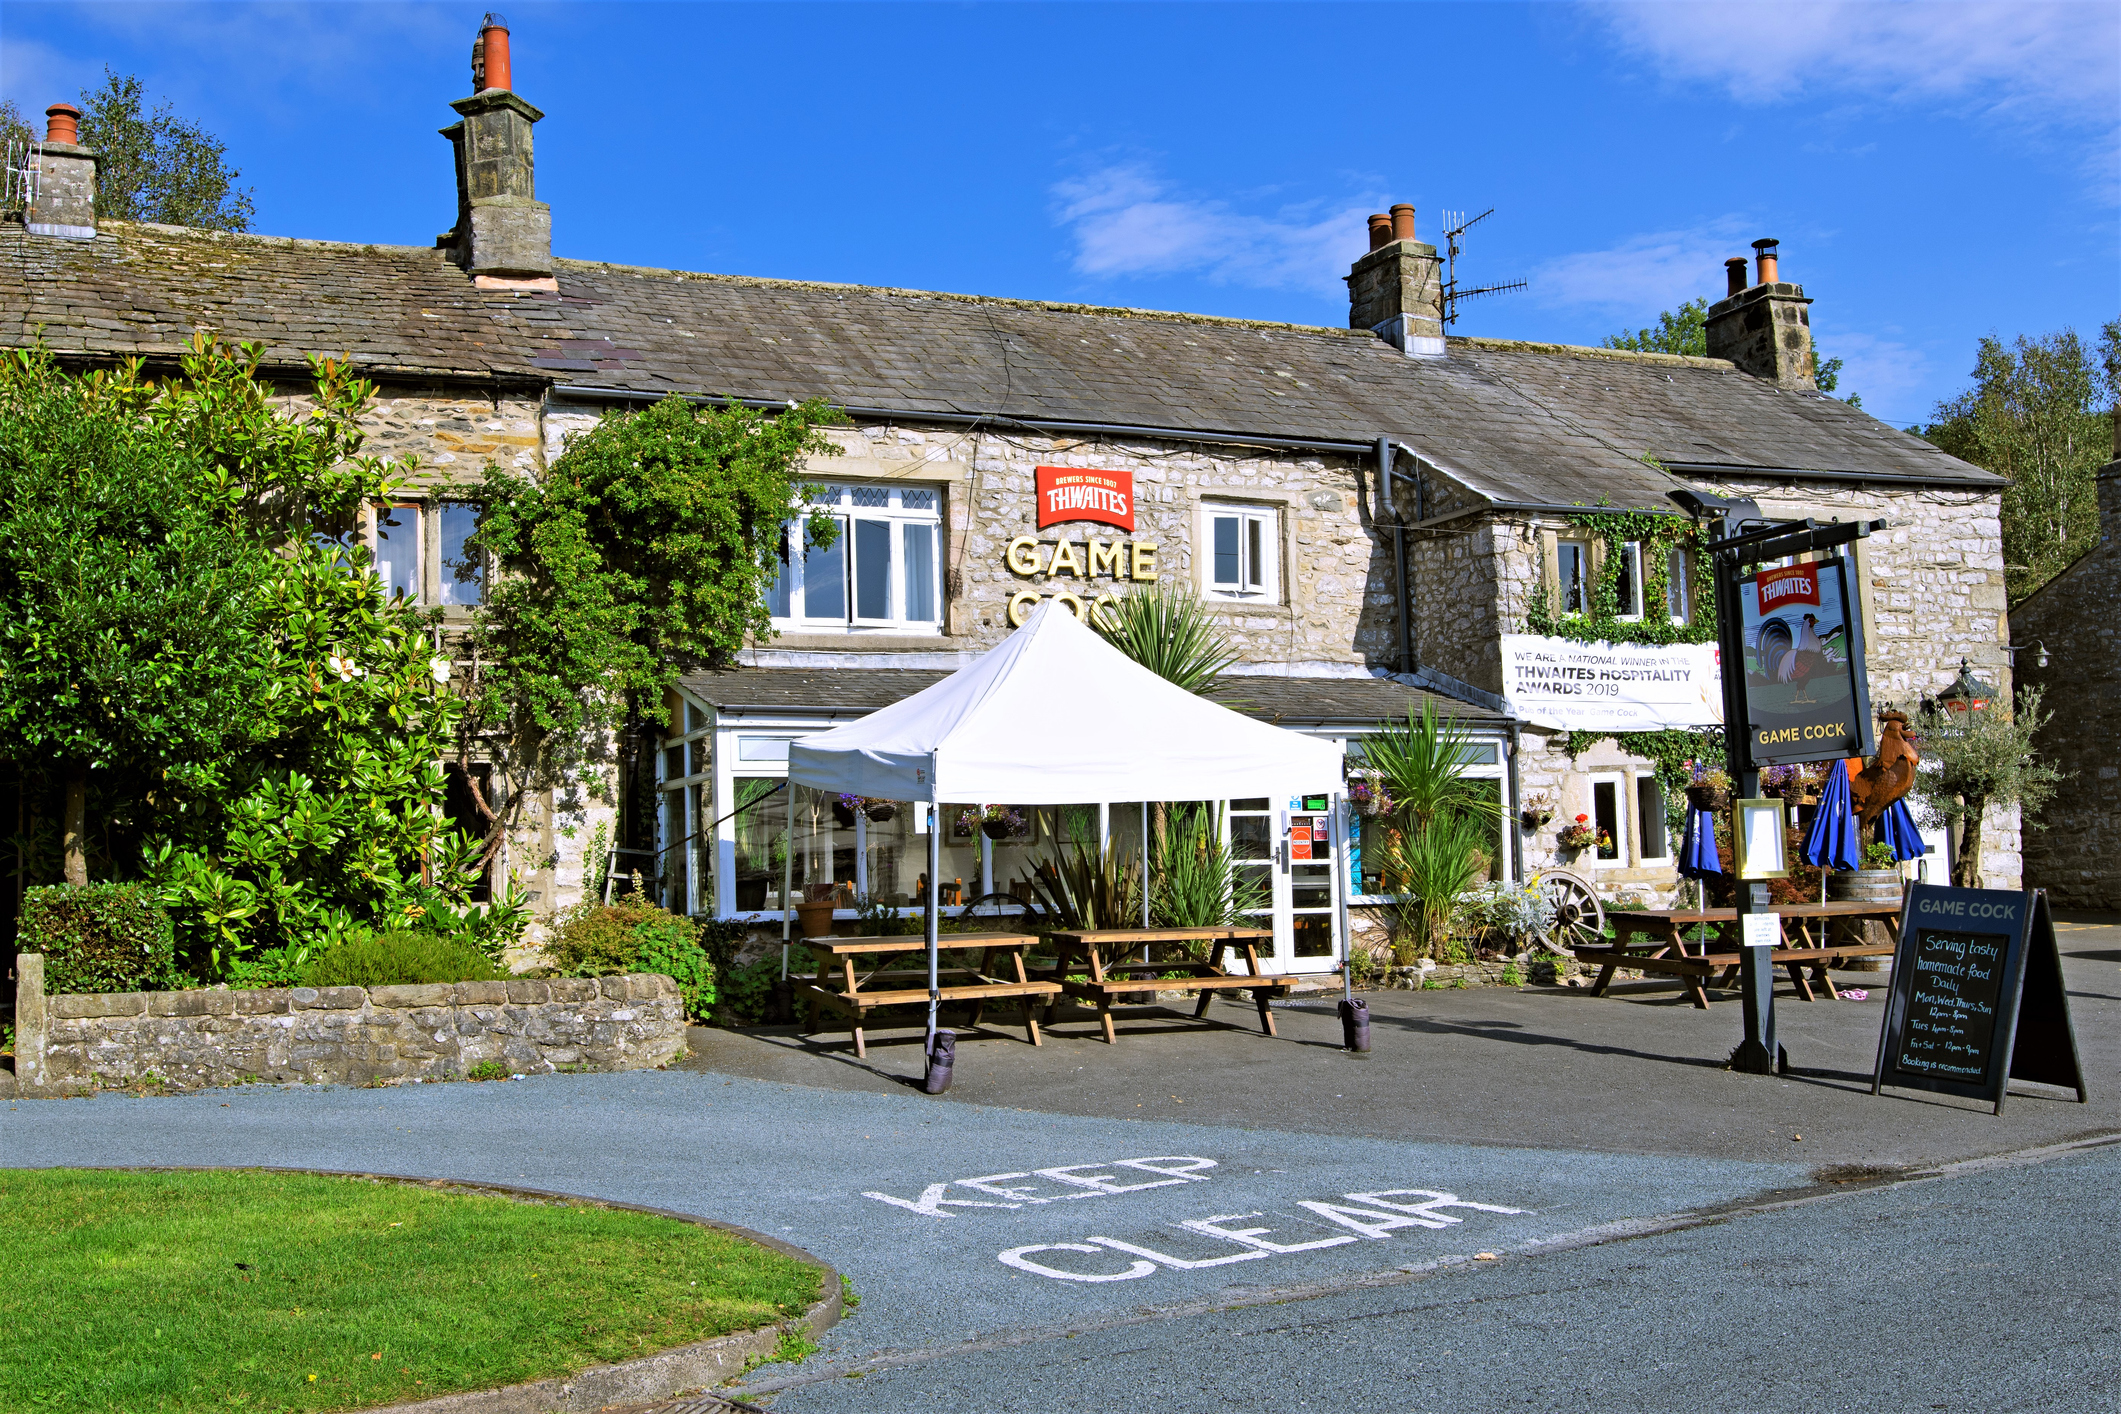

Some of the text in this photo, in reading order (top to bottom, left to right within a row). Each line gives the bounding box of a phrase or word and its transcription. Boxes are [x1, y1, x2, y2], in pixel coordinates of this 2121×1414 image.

[1055, 475, 1117, 488] BREWERS SINCE 1807
[1046, 485, 1128, 516] THWAITES
[1007, 535, 1159, 580] GAME
[1761, 577, 1812, 603] THWAITES
[1514, 651, 1691, 667] WE ARE A NATIONAL WINNER IN THE
[1515, 666, 1692, 682] THWAITES HOSPITALITY
[1515, 682, 1620, 697] AWARDS 2019
[1518, 706, 1535, 715] Pub
[1536, 707, 1547, 715] of
[1548, 707, 1564, 716] the
[1589, 708, 1615, 717] Game
[1617, 708, 1638, 717] Cock
[1758, 722, 1847, 745] GAME COCK
[1919, 899, 2016, 920] GAME COCK
[1925, 935, 1999, 962] Serving tasty
[1917, 955, 1991, 981] homemade food
[1929, 975, 1960, 996] Daily
[1911, 1019, 1929, 1031] Tues
[1901, 1053, 1930, 1071] Booking
[861, 1156, 1218, 1218] KEEP
[997, 1189, 1535, 1284] CLEAR
